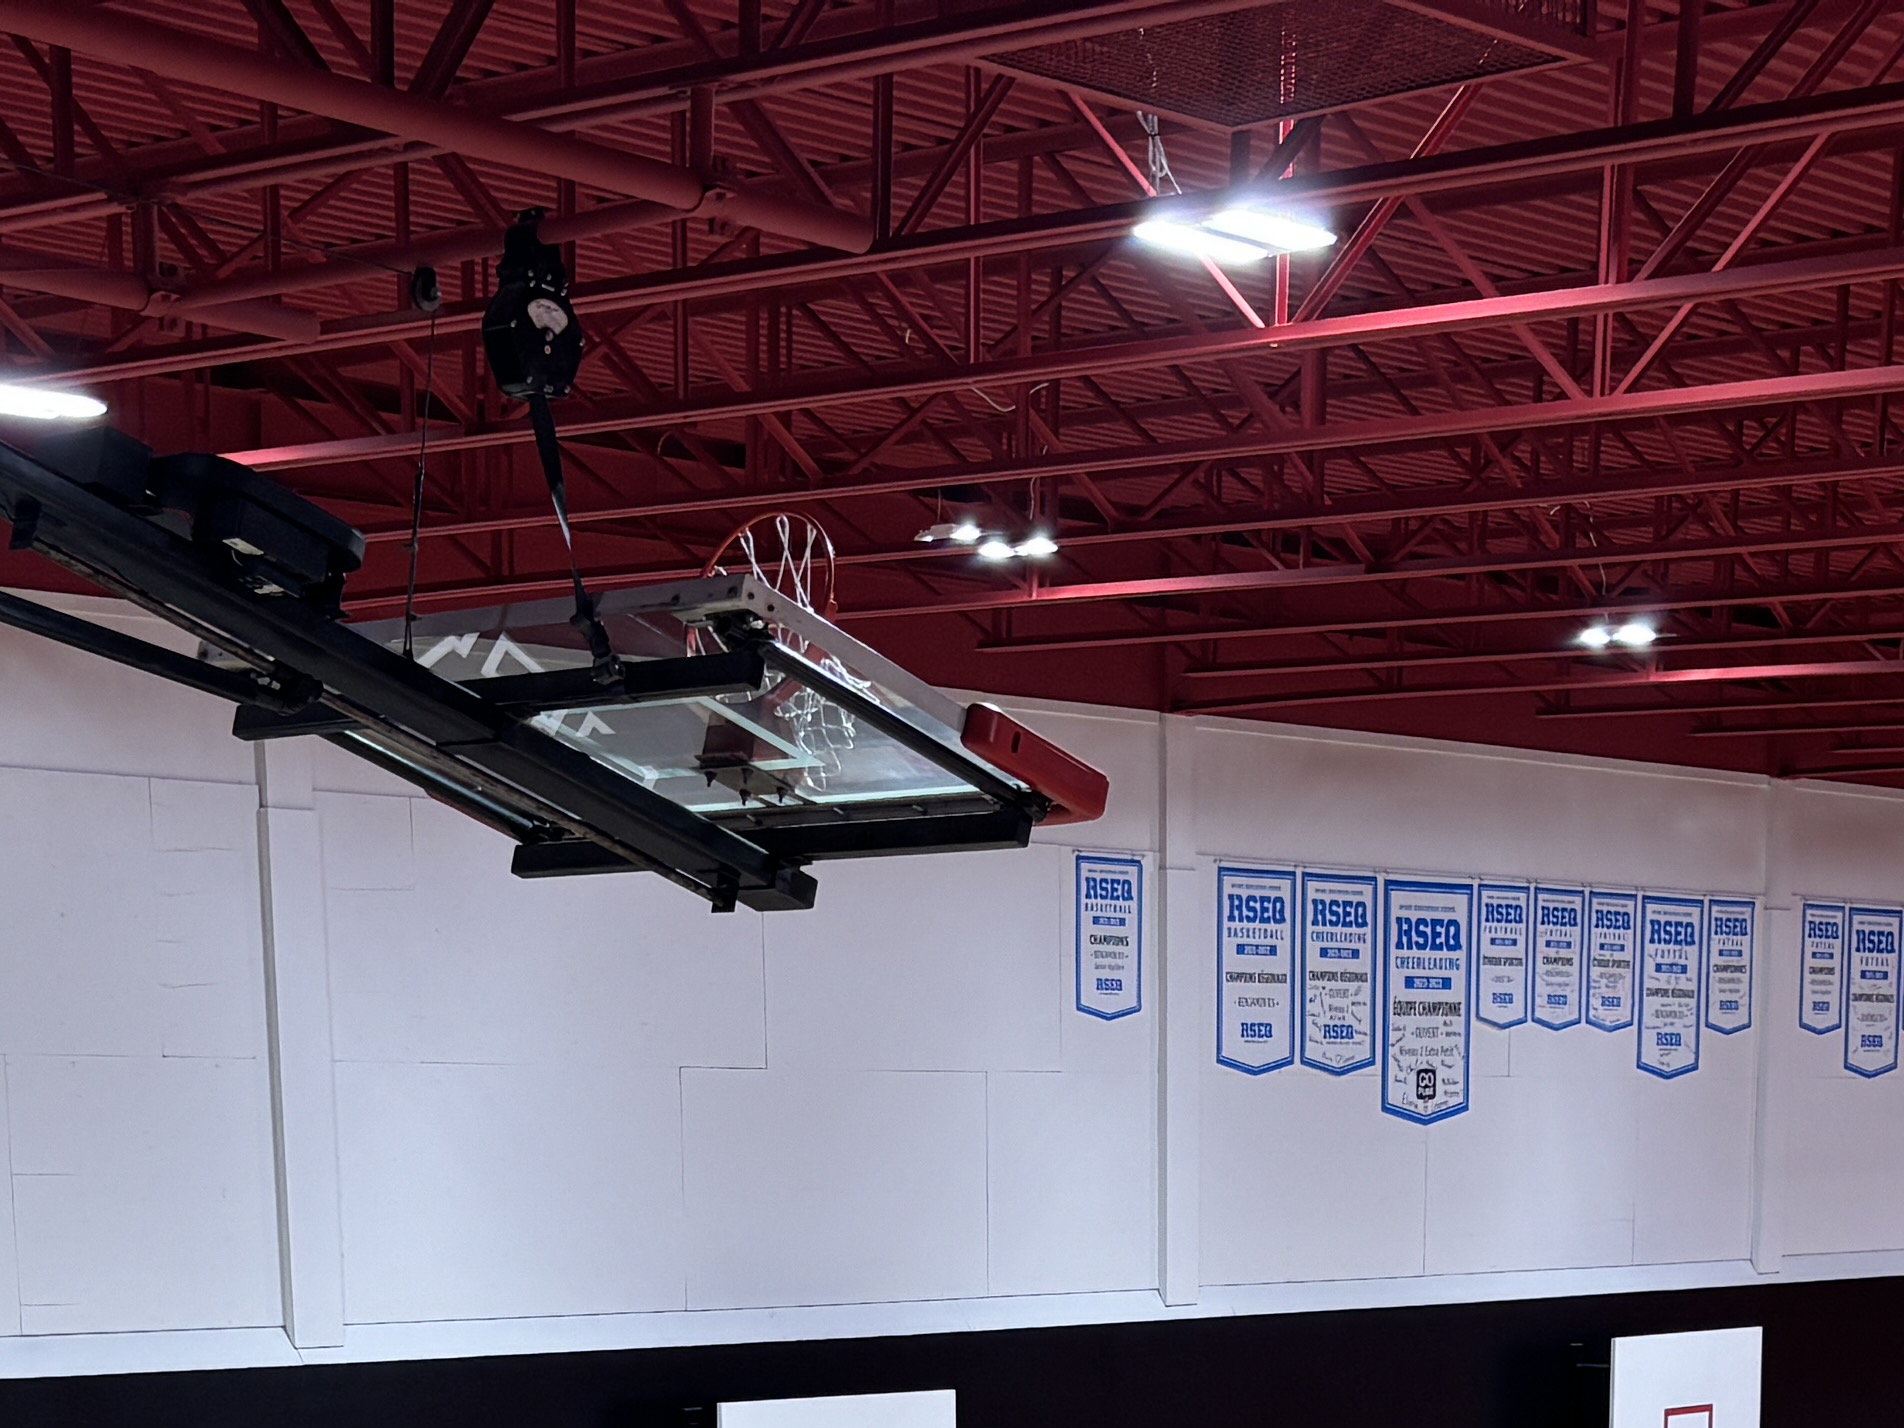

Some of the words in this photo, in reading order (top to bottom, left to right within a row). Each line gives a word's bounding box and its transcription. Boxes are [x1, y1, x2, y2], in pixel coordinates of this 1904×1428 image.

[1085, 877, 1134, 901] RSEQ
[1227, 894, 1286, 924] RSEQ
[1311, 899, 1368, 928] RSEQ
[1485, 903, 1523, 923] RSEQ
[1541, 906, 1578, 927] RSEQ
[1594, 909, 1631, 930] RSEQ
[1714, 917, 1749, 936] RSEQ
[1227, 928, 1284, 941] BASKETBALL
[1311, 931, 1367, 943] CHEERLEADING
[1395, 916, 1463, 952] RSEQ
[1484, 926, 1523, 936] FOOTBALL
[1649, 919, 1696, 947] RSEQ
[1808, 921, 1840, 939] RSEQ
[1090, 934, 1129, 947] CHAMPIONS
[1856, 929, 1896, 954] RSEQ
[1395, 956, 1461, 971] CHEERLEADING
[1241, 1023, 1273, 1038] RSEQ
[1323, 1024, 1354, 1039] RSEQ
